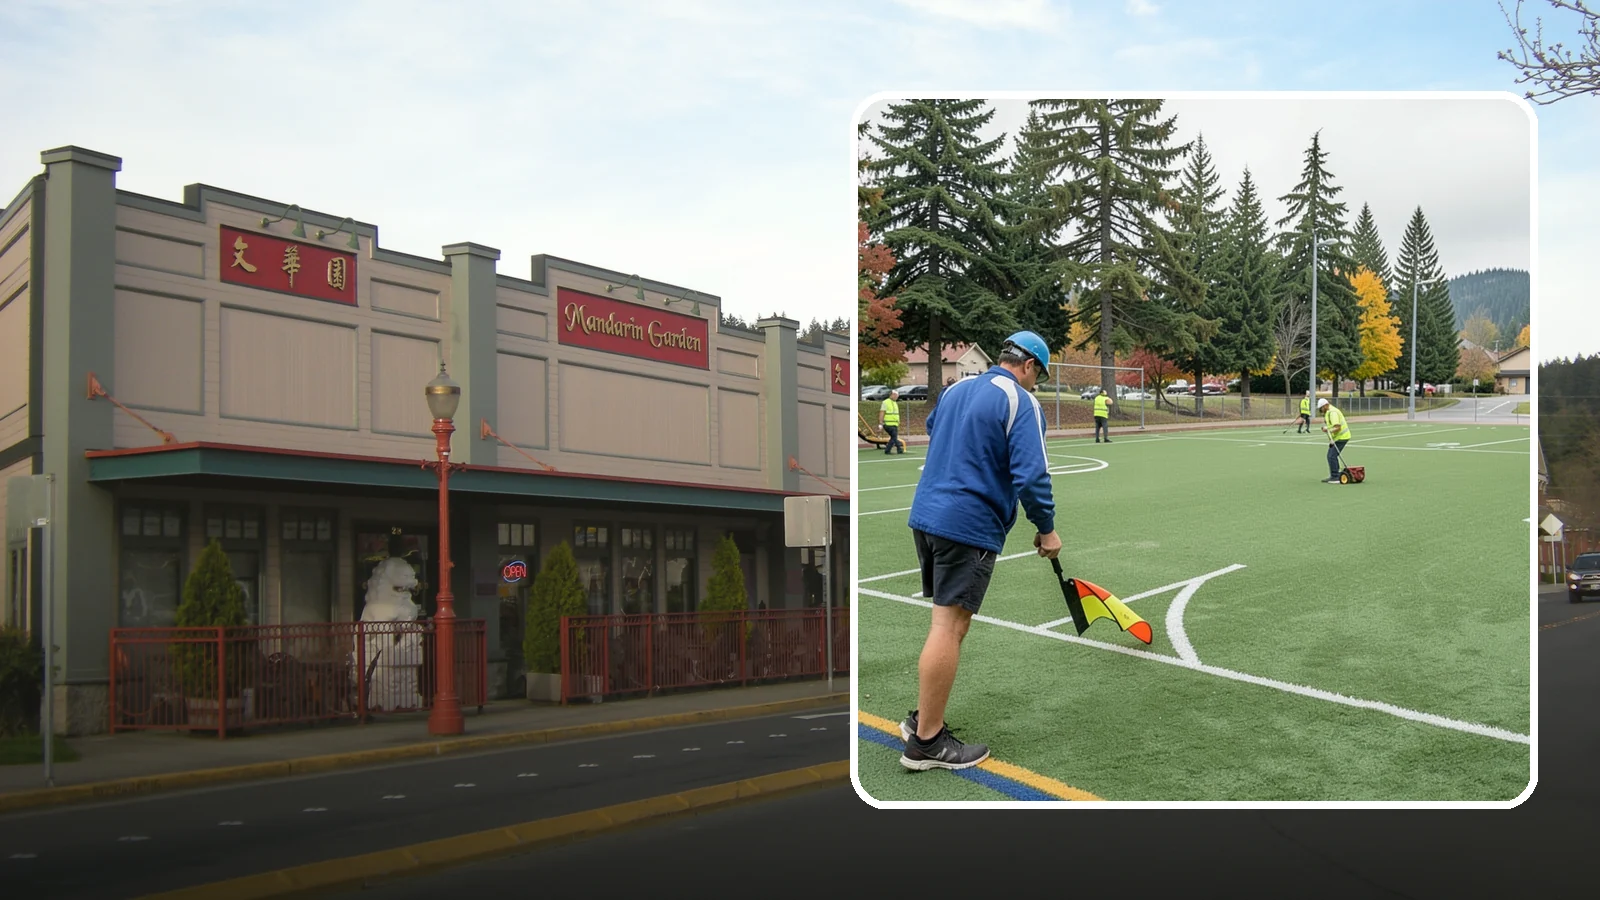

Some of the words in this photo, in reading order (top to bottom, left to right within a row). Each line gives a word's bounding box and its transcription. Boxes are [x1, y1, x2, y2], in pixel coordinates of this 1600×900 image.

[231, 235, 346, 291] 文華園
[564, 302, 644, 341] Mandarin
[648, 320, 701, 352] Garden
[503, 565, 526, 578] OPEN
